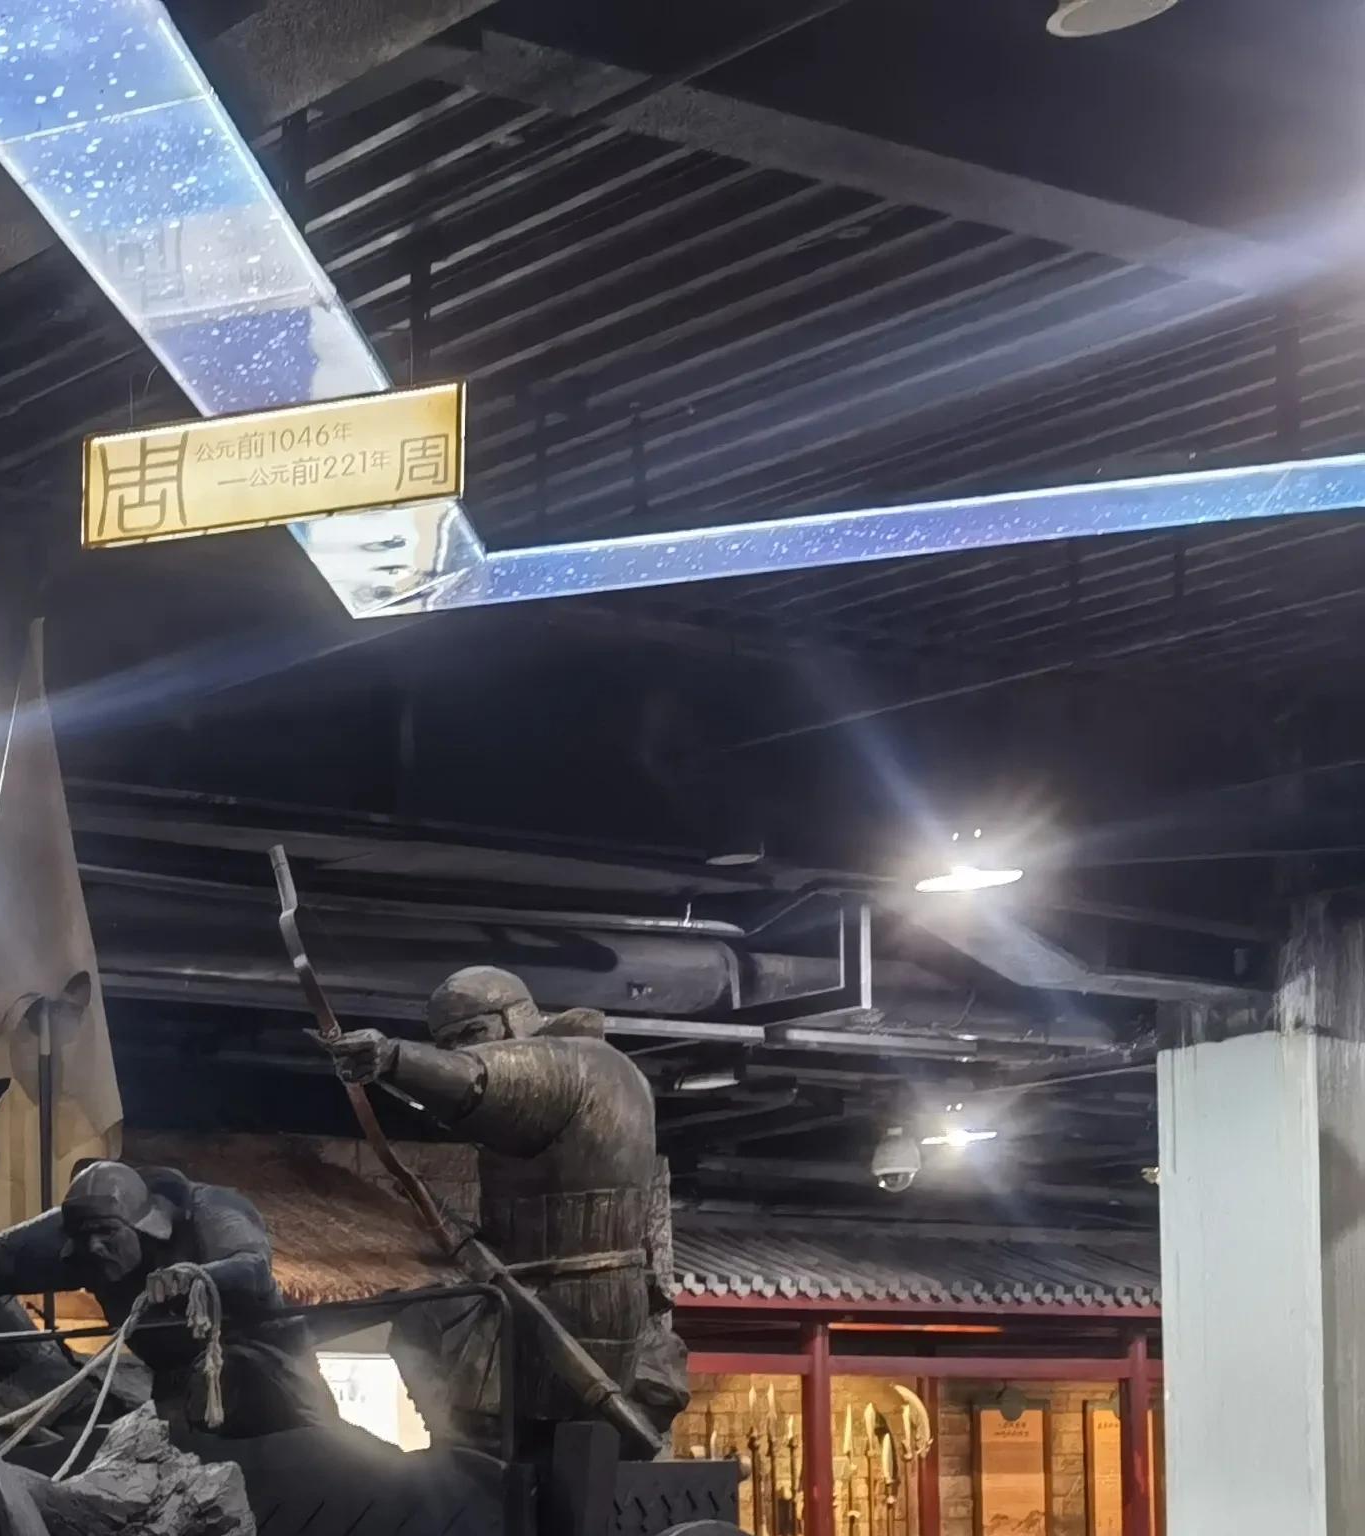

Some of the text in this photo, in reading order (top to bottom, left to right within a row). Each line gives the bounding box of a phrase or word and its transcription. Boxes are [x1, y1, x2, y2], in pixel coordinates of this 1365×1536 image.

[195, 422, 353, 463] 公元前1046年
[395, 432, 450, 492] 周
